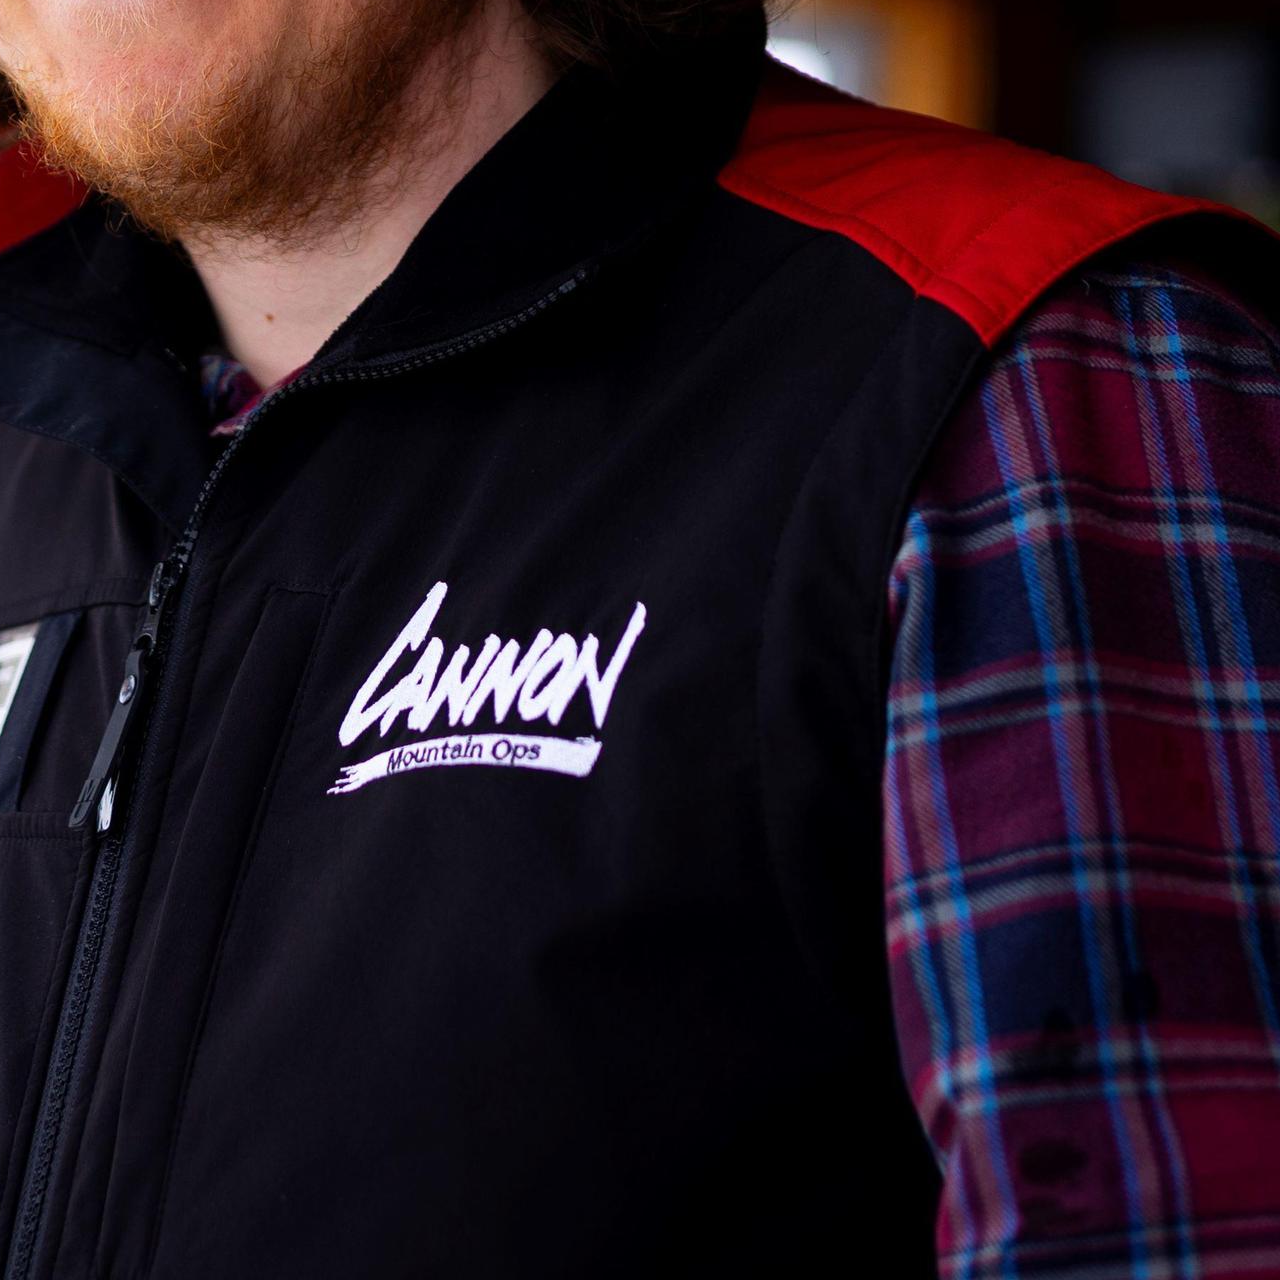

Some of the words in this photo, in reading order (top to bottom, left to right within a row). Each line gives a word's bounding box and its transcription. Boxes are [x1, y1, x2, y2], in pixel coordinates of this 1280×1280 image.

[338, 580, 647, 747] CANNON
[387, 735, 483, 775] Mountain
[491, 738, 542, 766] Ops
